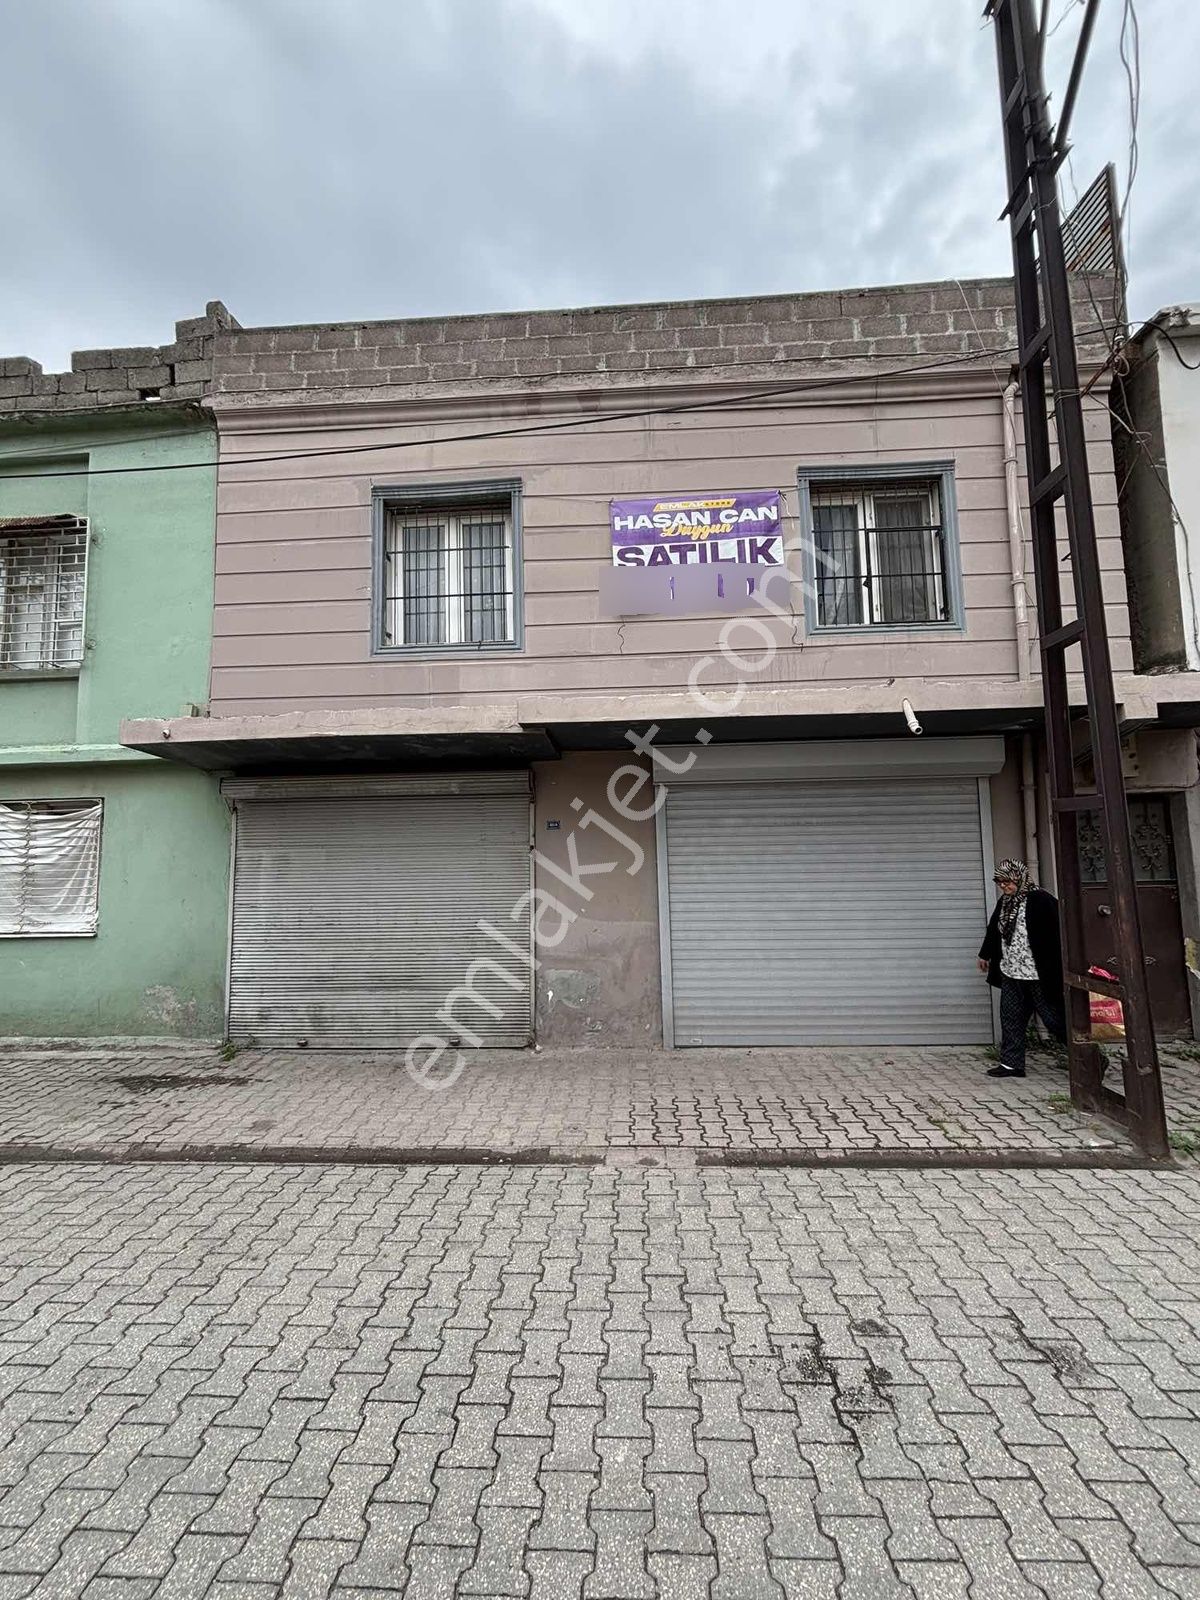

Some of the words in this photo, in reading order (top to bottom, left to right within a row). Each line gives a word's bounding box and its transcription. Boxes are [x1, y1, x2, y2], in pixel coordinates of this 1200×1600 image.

[614, 511, 710, 530] HASAN
[719, 506, 778, 523] CAN
[660, 523, 734, 540] Duygun
[617, 538, 779, 566] SATILIK
